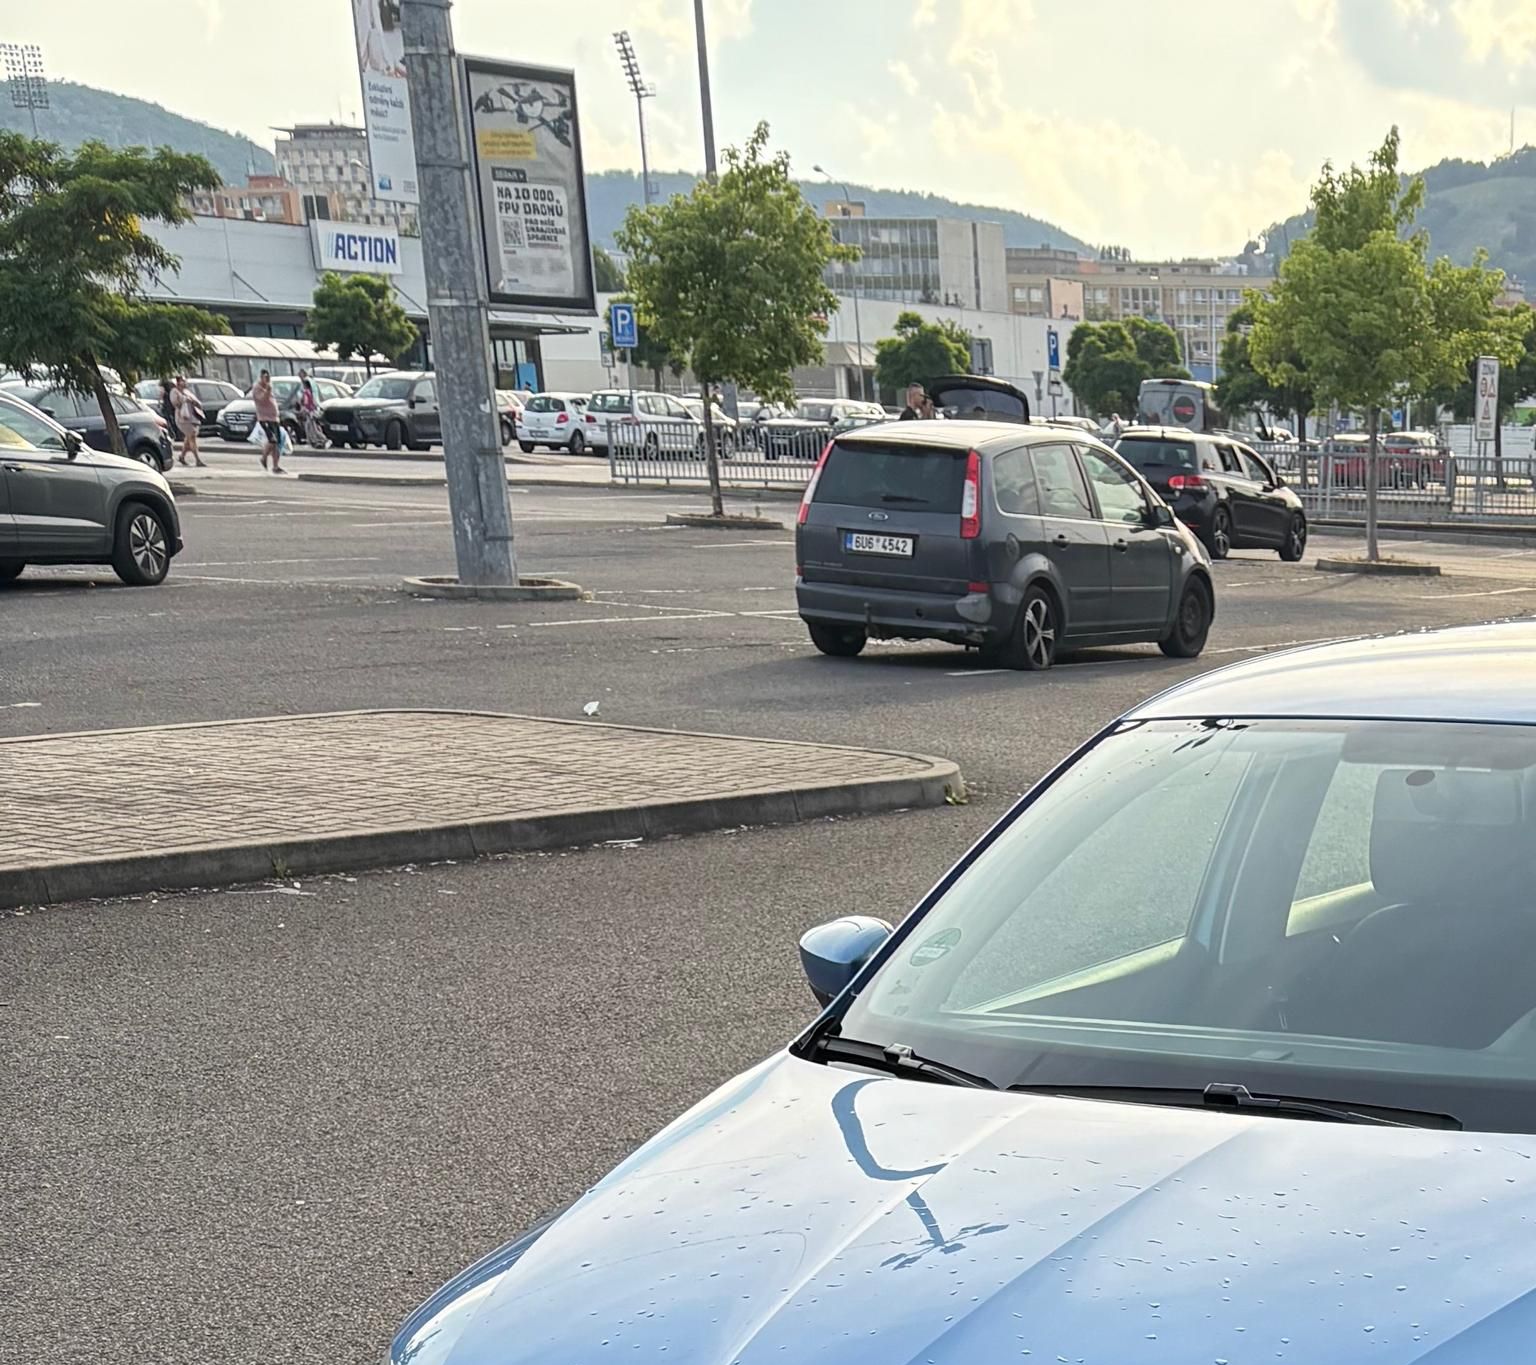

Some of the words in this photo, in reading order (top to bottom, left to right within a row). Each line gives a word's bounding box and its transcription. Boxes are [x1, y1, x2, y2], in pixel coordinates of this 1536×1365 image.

[497, 186, 512, 200] NA
[514, 187, 530, 200] 10
[532, 188, 554, 202] 000
[498, 201, 519, 214] FPV
[523, 199, 563, 217] DRONŮ
[335, 232, 396, 264] ACTION
[617, 309, 631, 334] P
[1050, 334, 1057, 356] P
[881, 538, 908, 553] 4542
